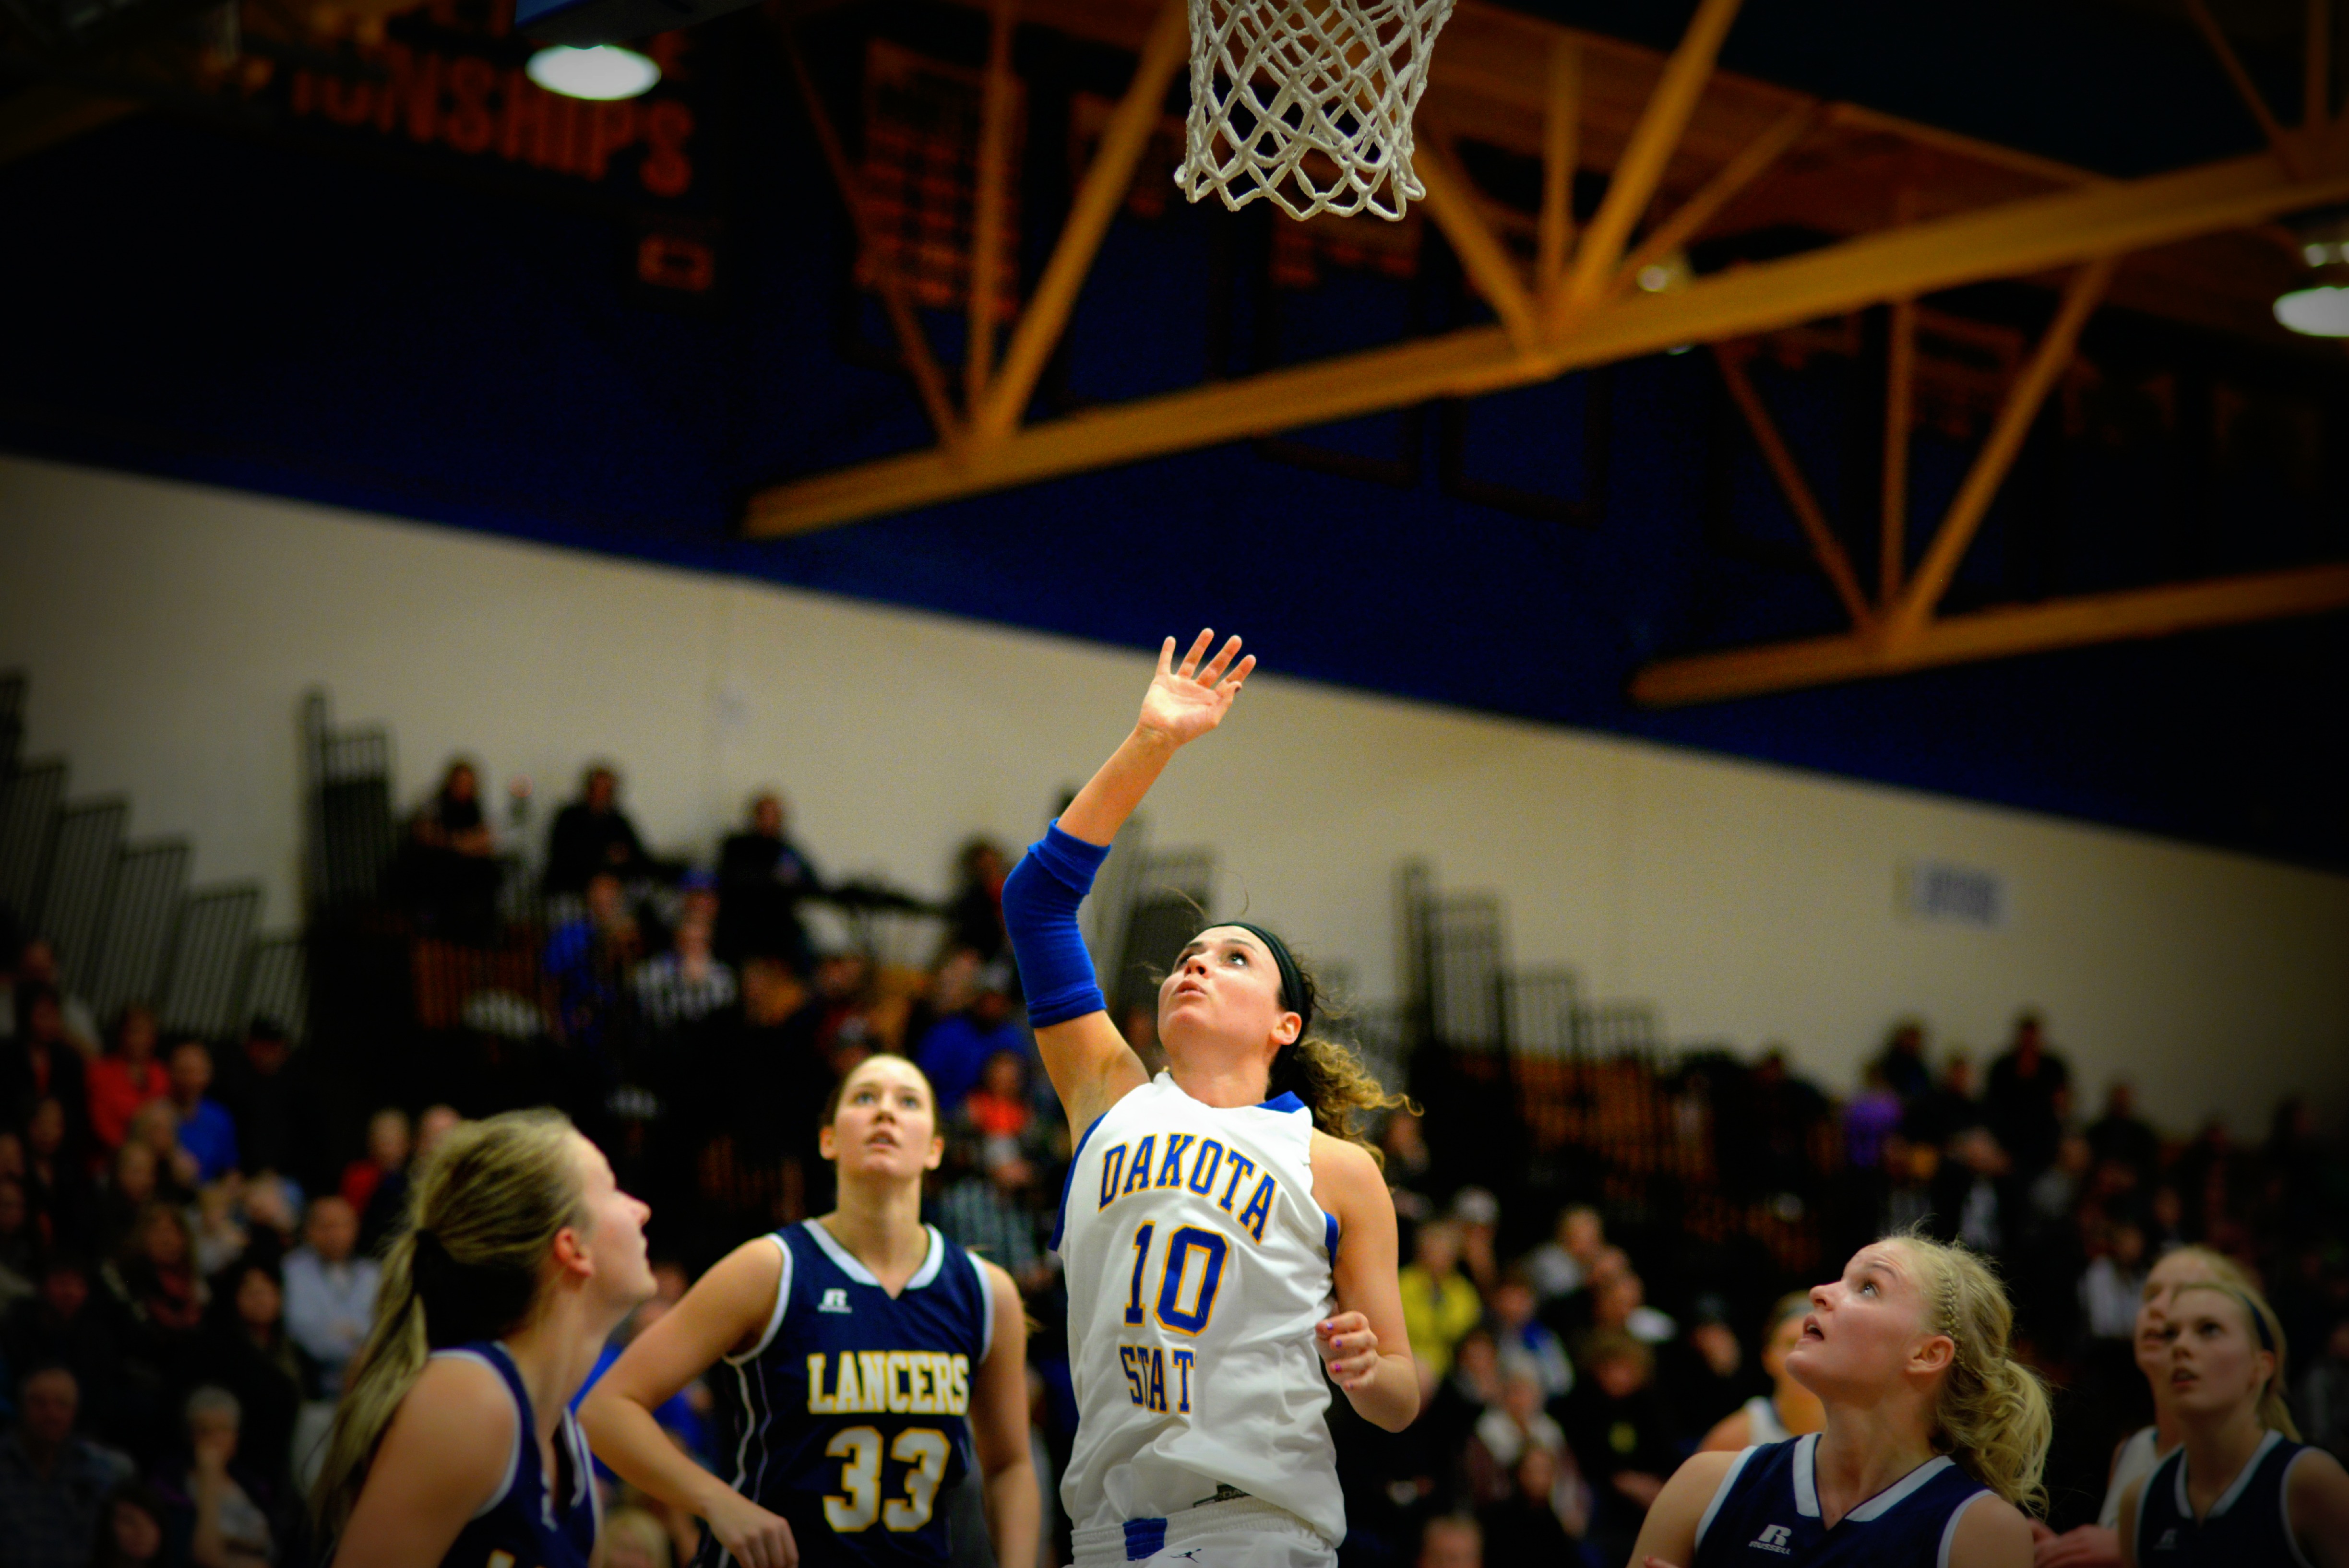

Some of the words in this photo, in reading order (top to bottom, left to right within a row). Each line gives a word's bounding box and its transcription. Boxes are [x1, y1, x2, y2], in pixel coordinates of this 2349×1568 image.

[1098, 1133, 1277, 1245] DAKOTA
[1124, 1221, 1230, 1337] 10
[807, 1350, 970, 1415] LANCERS
[823, 1425, 952, 1532] 33
[1748, 1541, 1791, 1555] RUSSELL
